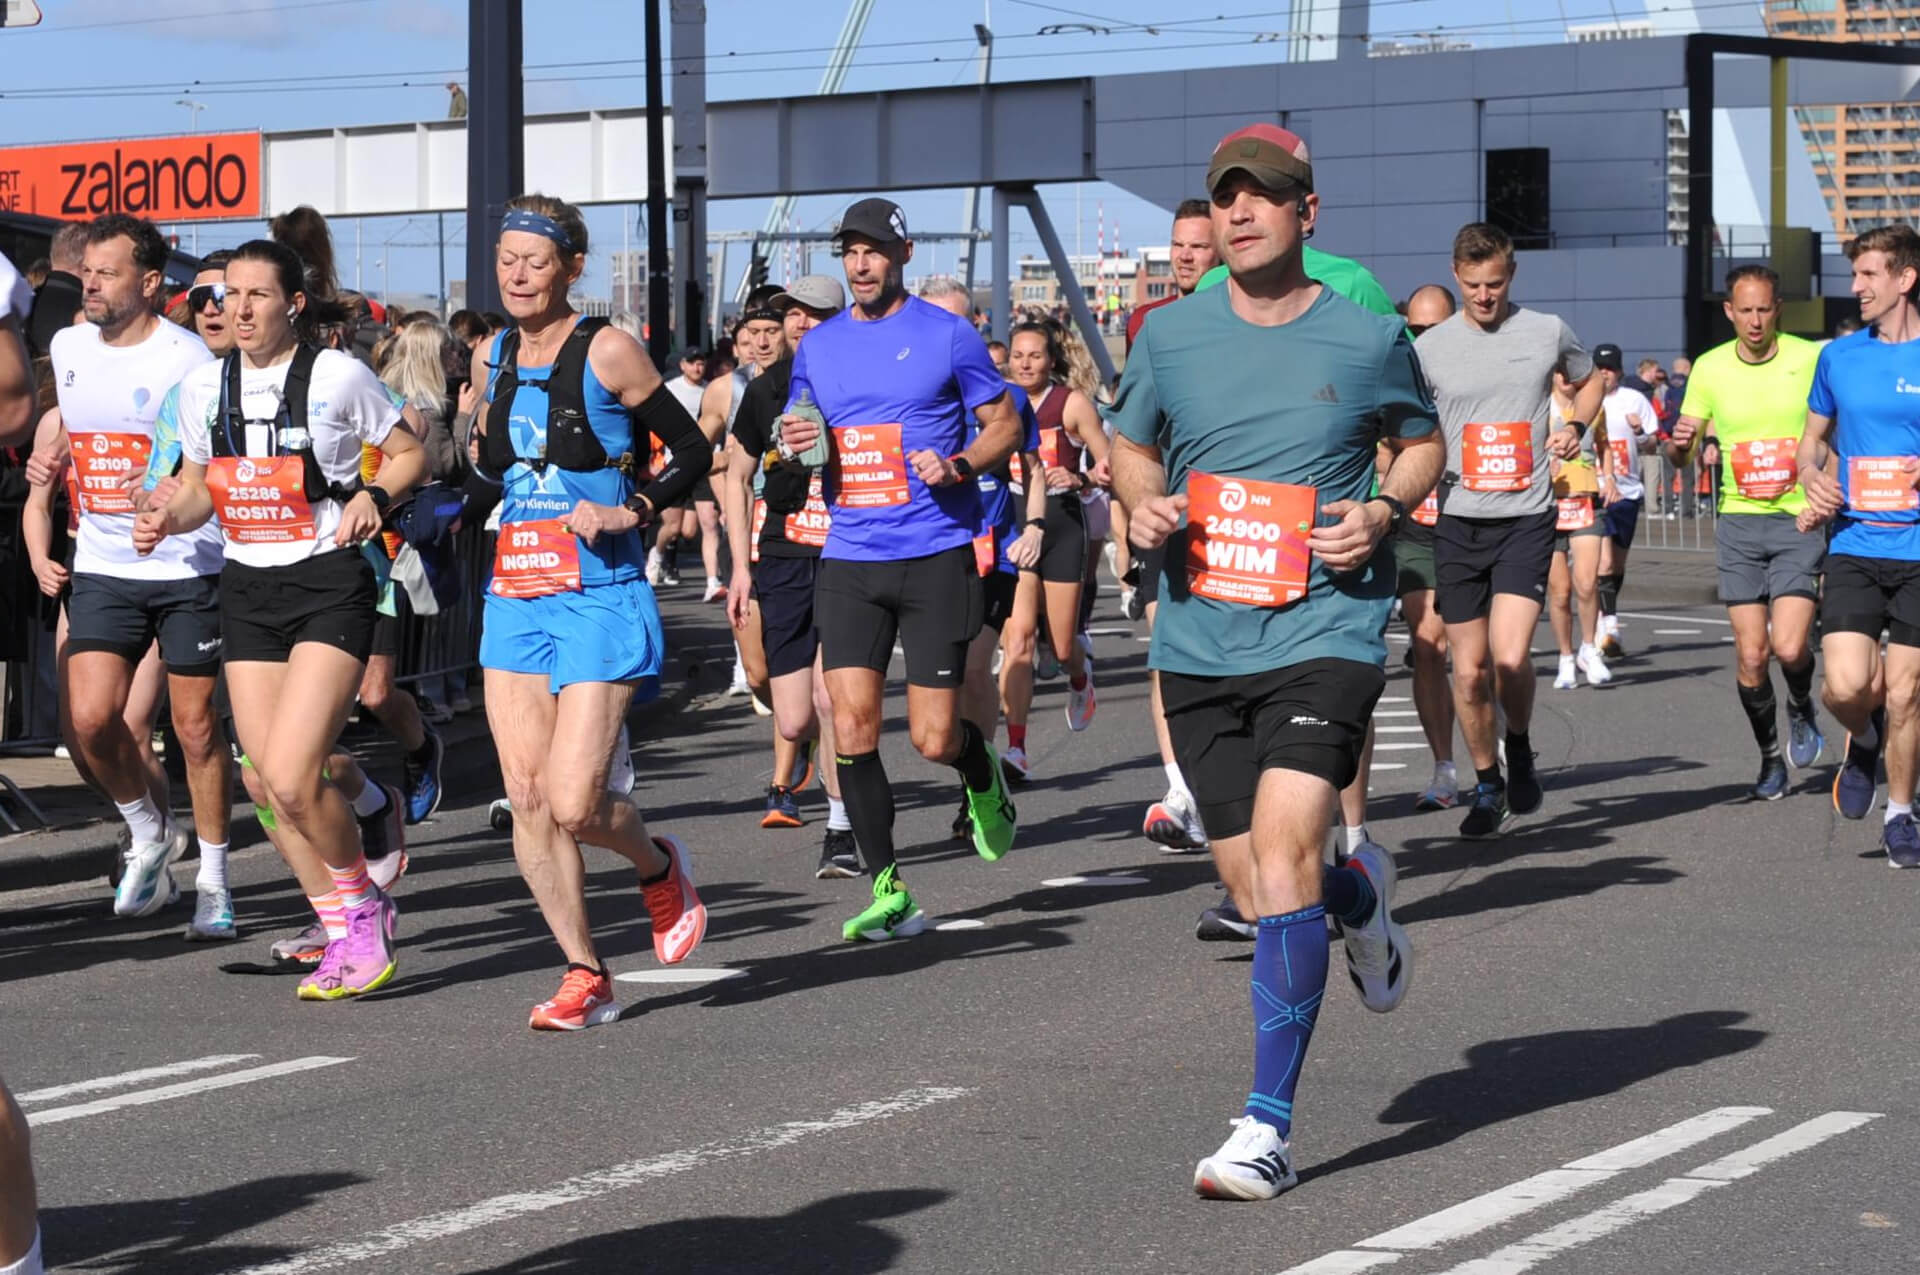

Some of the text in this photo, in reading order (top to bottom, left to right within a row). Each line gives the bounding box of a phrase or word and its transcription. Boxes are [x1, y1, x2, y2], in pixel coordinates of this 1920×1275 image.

[61, 143, 246, 215] zalando
[88, 457, 132, 471] 25109
[840, 451, 883, 467] 20073
[1477, 458, 1518, 474] JOB
[855, 470, 895, 481] WILLEM
[1741, 469, 1791, 484] JASPER
[228, 486, 281, 501] 25286
[1250, 494, 1271, 507] NN
[224, 505, 297, 521] ROSITA
[1205, 515, 1281, 543] 24900
[512, 531, 540, 548] 873
[502, 552, 561, 571] INGRID
[1206, 540, 1278, 575] WIM
